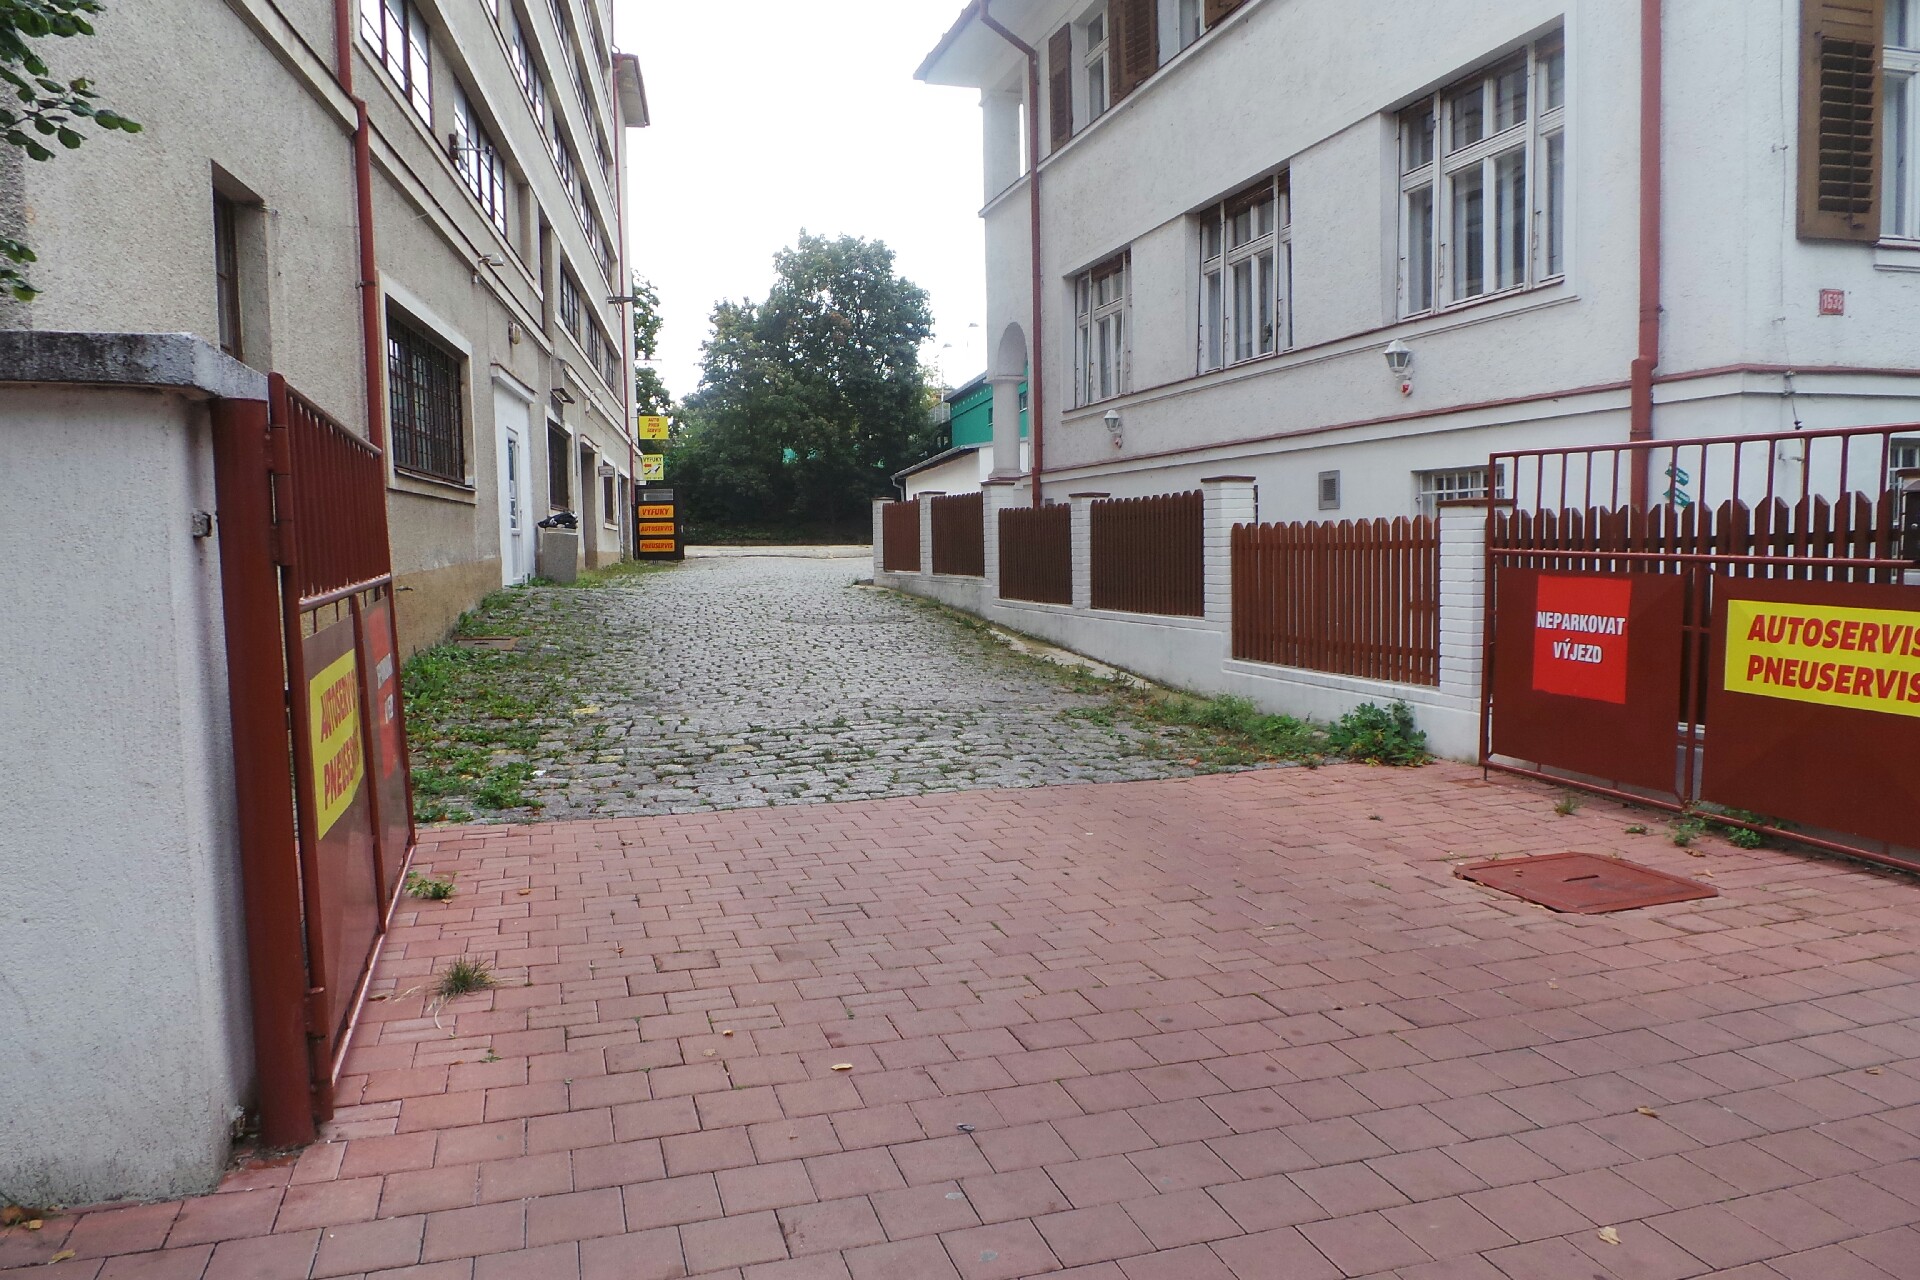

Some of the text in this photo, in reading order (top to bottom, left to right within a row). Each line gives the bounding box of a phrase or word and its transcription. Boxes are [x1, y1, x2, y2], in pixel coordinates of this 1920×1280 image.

[1536, 611, 1626, 636] NEPARKOVAT
[1553, 637, 1603, 664] VÝJEZD
[1746, 654, 1920, 704] PNEUSERVIS
